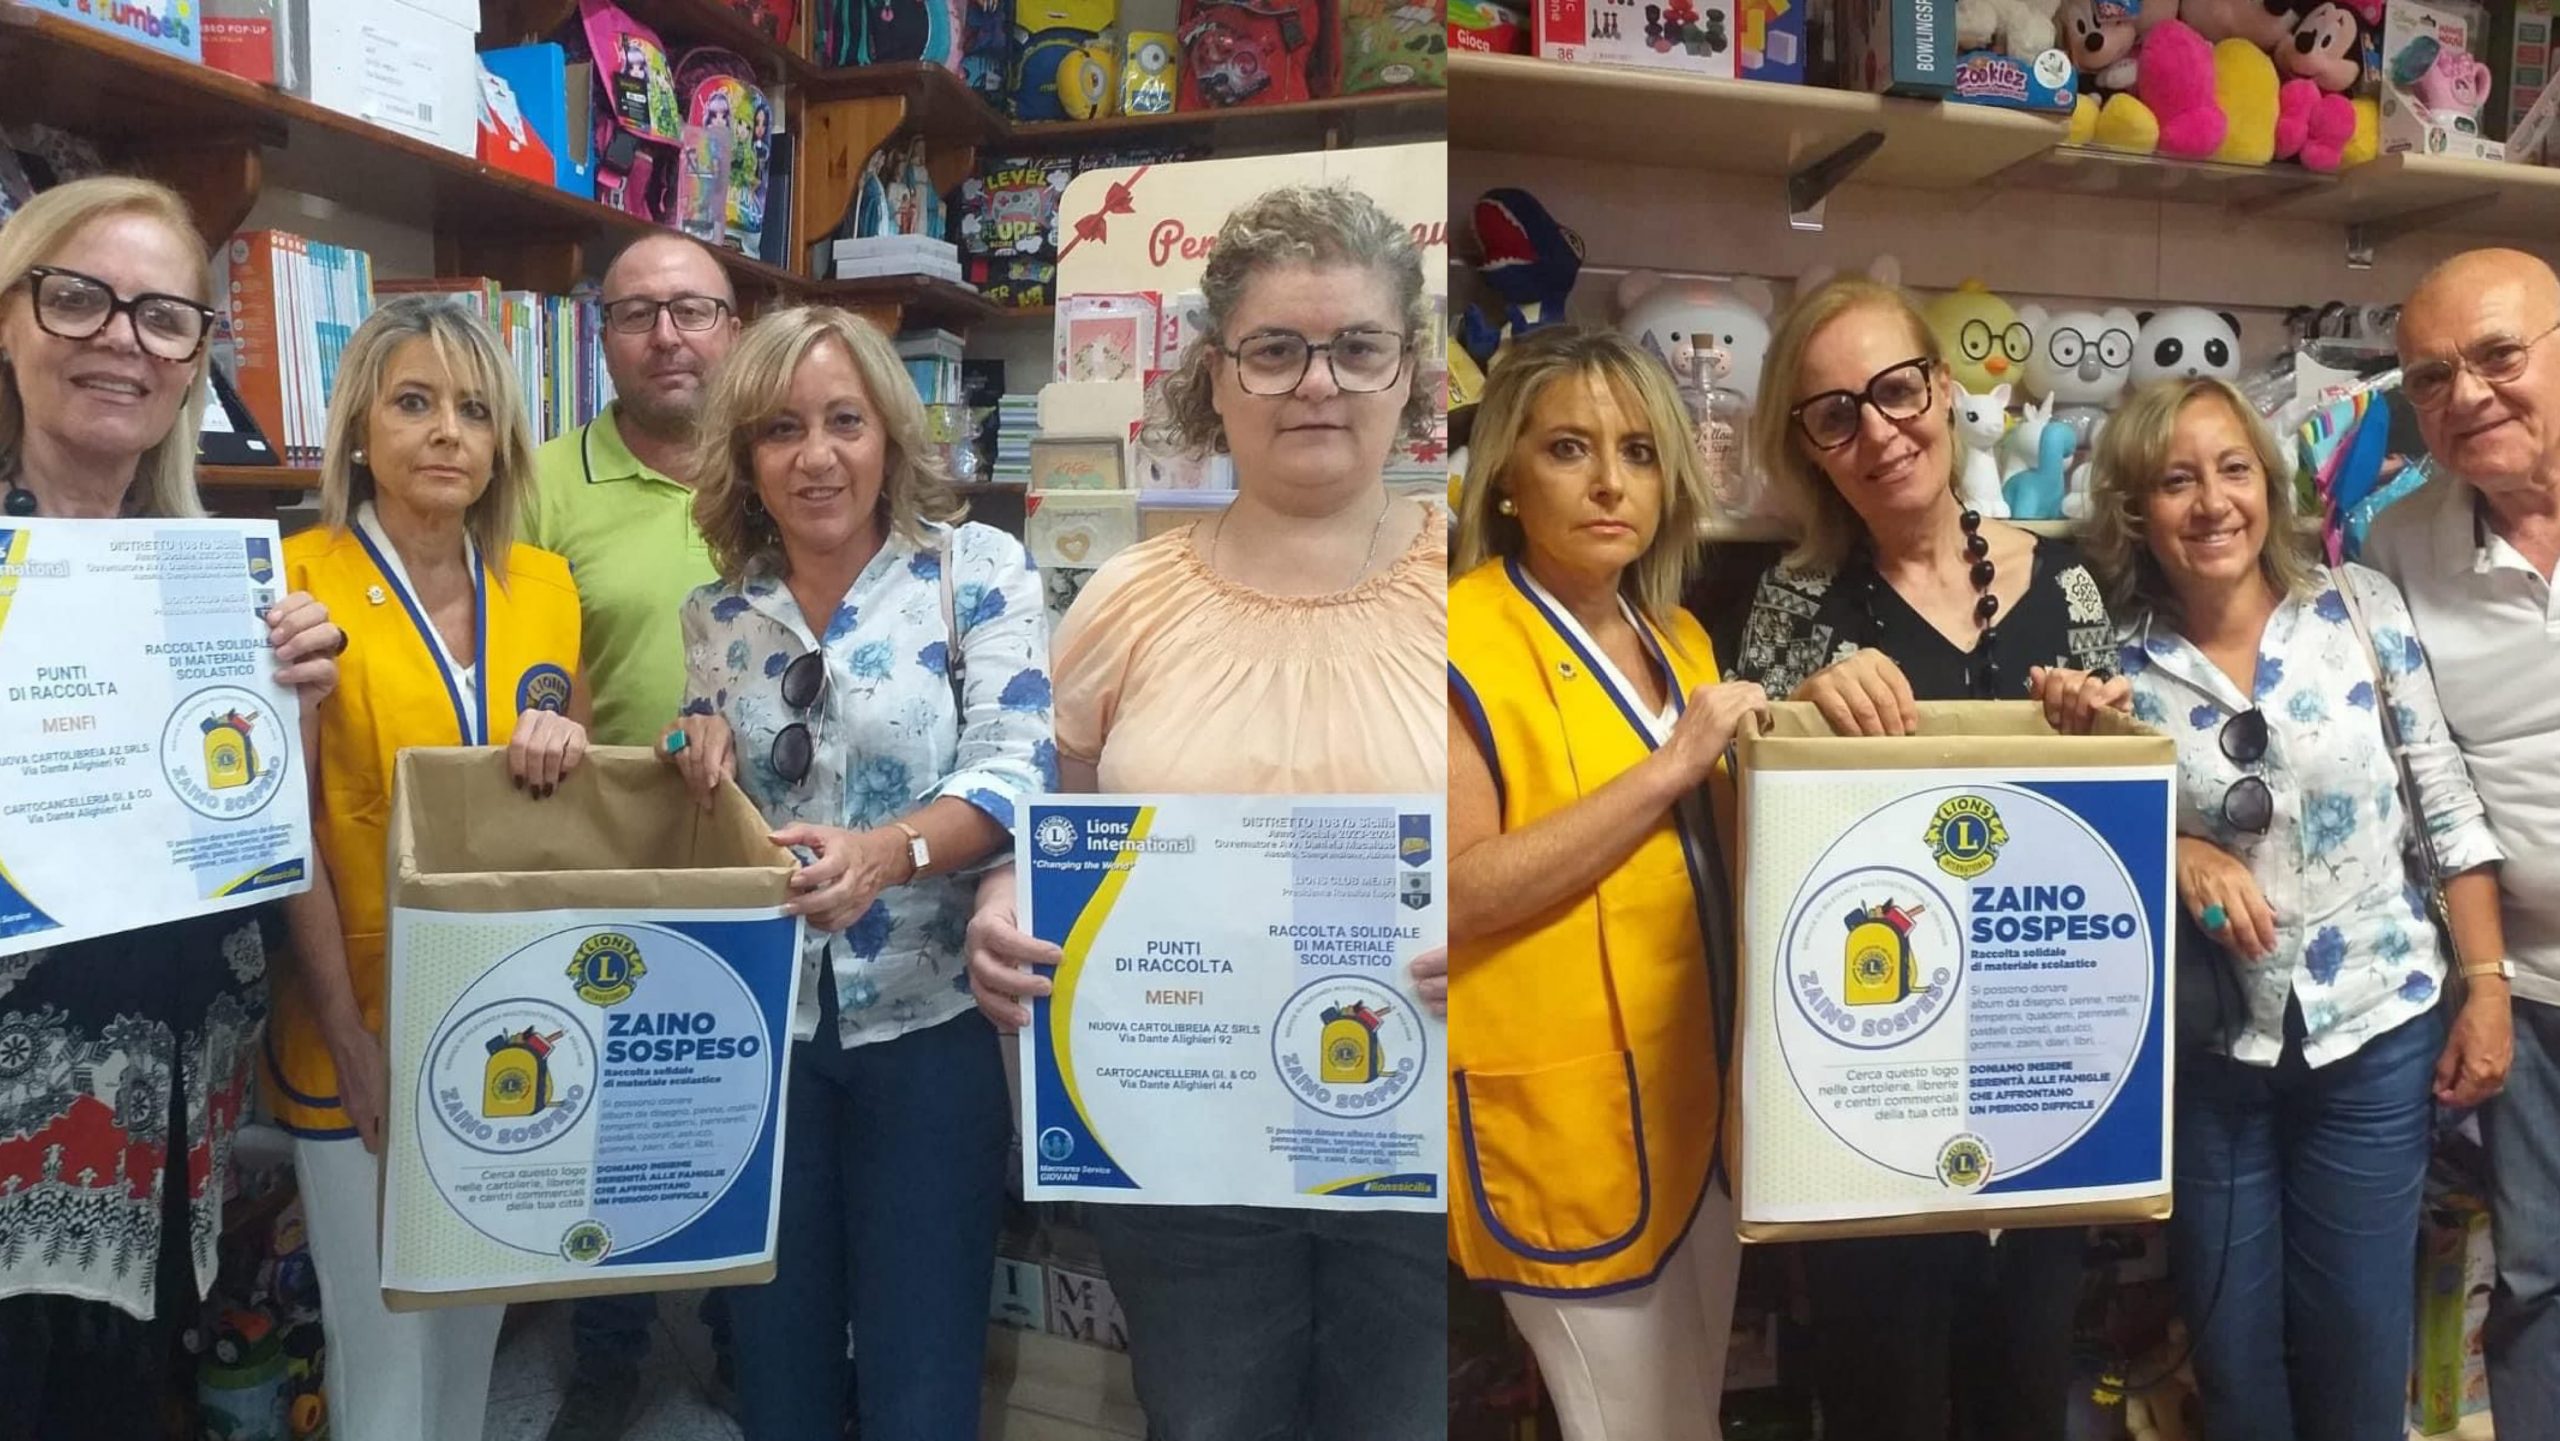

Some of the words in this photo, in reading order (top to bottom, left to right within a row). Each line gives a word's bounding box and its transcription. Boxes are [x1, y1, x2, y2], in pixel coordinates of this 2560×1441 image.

[1956, 61, 2026, 90] Zookiez
[987, 168, 1047, 190] LEVEL
[145, 641, 214, 655] RACCOLTA
[218, 638, 273, 650] SOLIDALE
[169, 656, 182, 667] DI
[185, 652, 255, 665] MATERIALE
[37, 665, 87, 681] PUNTI
[177, 665, 255, 680] SCOLASTICO
[9, 687, 26, 701] DI
[31, 682, 118, 699] RACCOLTA
[42, 716, 96, 733] MENFI
[0, 755, 28, 766] UOVA
[109, 746, 121, 756] AZ
[22, 766, 38, 775] Via
[40, 763, 69, 774] Dante
[115, 757, 126, 766] 92
[3, 794, 109, 815] CARTOCANCELLERIA
[137, 788, 152, 798] CO
[1942, 799, 1991, 816] LIONS
[28, 814, 43, 824] Via
[46, 812, 75, 822] Dante
[1242, 817, 1314, 828] DISTRETTO
[1359, 817, 1396, 828] Sicilia
[1087, 819, 1129, 834] Lions
[1051, 829, 1062, 841] L
[1958, 822, 1979, 849] L
[1087, 837, 1195, 852] International
[1084, 860, 1099, 870] the
[1362, 878, 1396, 886] MENFI
[1972, 885, 2086, 912] ZAINO
[1269, 925, 1347, 938] RACCOLTA
[1350, 926, 1421, 939] SOLIDALE
[1971, 913, 2137, 943] SOSPESO
[585, 936, 631, 952] LIONS
[1147, 941, 1201, 955] PUNTI
[1294, 940, 1308, 951] DI
[1312, 940, 1395, 952] MATERIALE
[1300, 954, 1392, 967] SCOLASTICO
[1971, 950, 2020, 959] Raccolta
[2023, 947, 2066, 957] solidale
[598, 956, 617, 981] L
[1116, 958, 1132, 972] DI
[1138, 958, 1233, 973] RACCOLTA
[1971, 962, 1982, 972] di
[1984, 959, 2038, 970] materiale
[2041, 959, 2097, 969] scolastico
[1145, 990, 1204, 1005] MENFI
[1799, 970, 1856, 1033] ZAINO
[1860, 967, 1950, 1037] SOSPESO
[608, 1012, 716, 1037] ZAINO
[1088, 1021, 1127, 1031] NUOVA
[1130, 1022, 1211, 1033] CARTOLIBREIA
[1214, 1024, 1228, 1033] AZ
[1231, 1024, 1261, 1034] SRLS
[1119, 1033, 1136, 1043] Via
[1138, 1034, 1169, 1043] Dante
[1172, 1034, 1216, 1046] Alighieri
[1218, 1035, 1232, 1044] 92
[606, 1035, 760, 1063] SOSPESO
[604, 1068, 650, 1077] Raccolta
[1096, 1067, 1209, 1079] CARTOCANCELLERIA
[1230, 1071, 1237, 1079] &
[1240, 1070, 1257, 1080] CO
[1846, 1070, 1882, 1081] Cerca
[1886, 1067, 1928, 1080] questo
[1931, 1066, 1958, 1078] logo
[1969, 1063, 2024, 1073] DONIAMO
[2028, 1061, 2073, 1070] INSIEME
[603, 1078, 614, 1088] di
[1120, 1080, 1137, 1089] Via
[1140, 1080, 1171, 1089] Dante
[1173, 1080, 1216, 1091] Alighieri
[1219, 1081, 1233, 1090] 44
[1281, 1053, 1331, 1104] ZAINO
[1335, 1057, 1414, 1109] SOSPESO
[1819, 1085, 1848, 1096] nelle
[1917, 1079, 1958, 1091] librerie
[1969, 1075, 2025, 1088] SERENITÀ
[2028, 1074, 2056, 1085] ALLE
[2059, 1073, 2111, 1083] FAMIGLIE
[1834, 1101, 1841, 1109] e
[1845, 1096, 1881, 1108] centri
[1884, 1094, 1958, 1107] commerciali
[1969, 1092, 1992, 1101] CHE
[1996, 1088, 2073, 1099] AFFRONTANO
[440, 1087, 493, 1140] ZAINO
[497, 1084, 584, 1144] SOSPESO
[1875, 1109, 1904, 1120] della
[1908, 1109, 1928, 1119] tua
[1932, 1106, 1958, 1117] città
[1969, 1106, 1986, 1114] UN
[1989, 1103, 2039, 1114] PERIODO
[2042, 1100, 2095, 1111] DIFFICILE
[481, 1170, 515, 1180] Cerca
[518, 1168, 558, 1178] questo
[561, 1166, 587, 1177] logo
[650, 1172, 676, 1181] ALLE
[1041, 1173, 1078, 1181] GIOVANI
[455, 1183, 482, 1192] nelle
[546, 1177, 586, 1187] librerie
[595, 1187, 616, 1195] CHE
[479, 1191, 512, 1202] centri
[515, 1188, 585, 1200] commerciali
[594, 1197, 609, 1205] UN
[506, 1201, 534, 1211] della
[537, 1200, 556, 1209] tua
[559, 1198, 584, 1208] città
